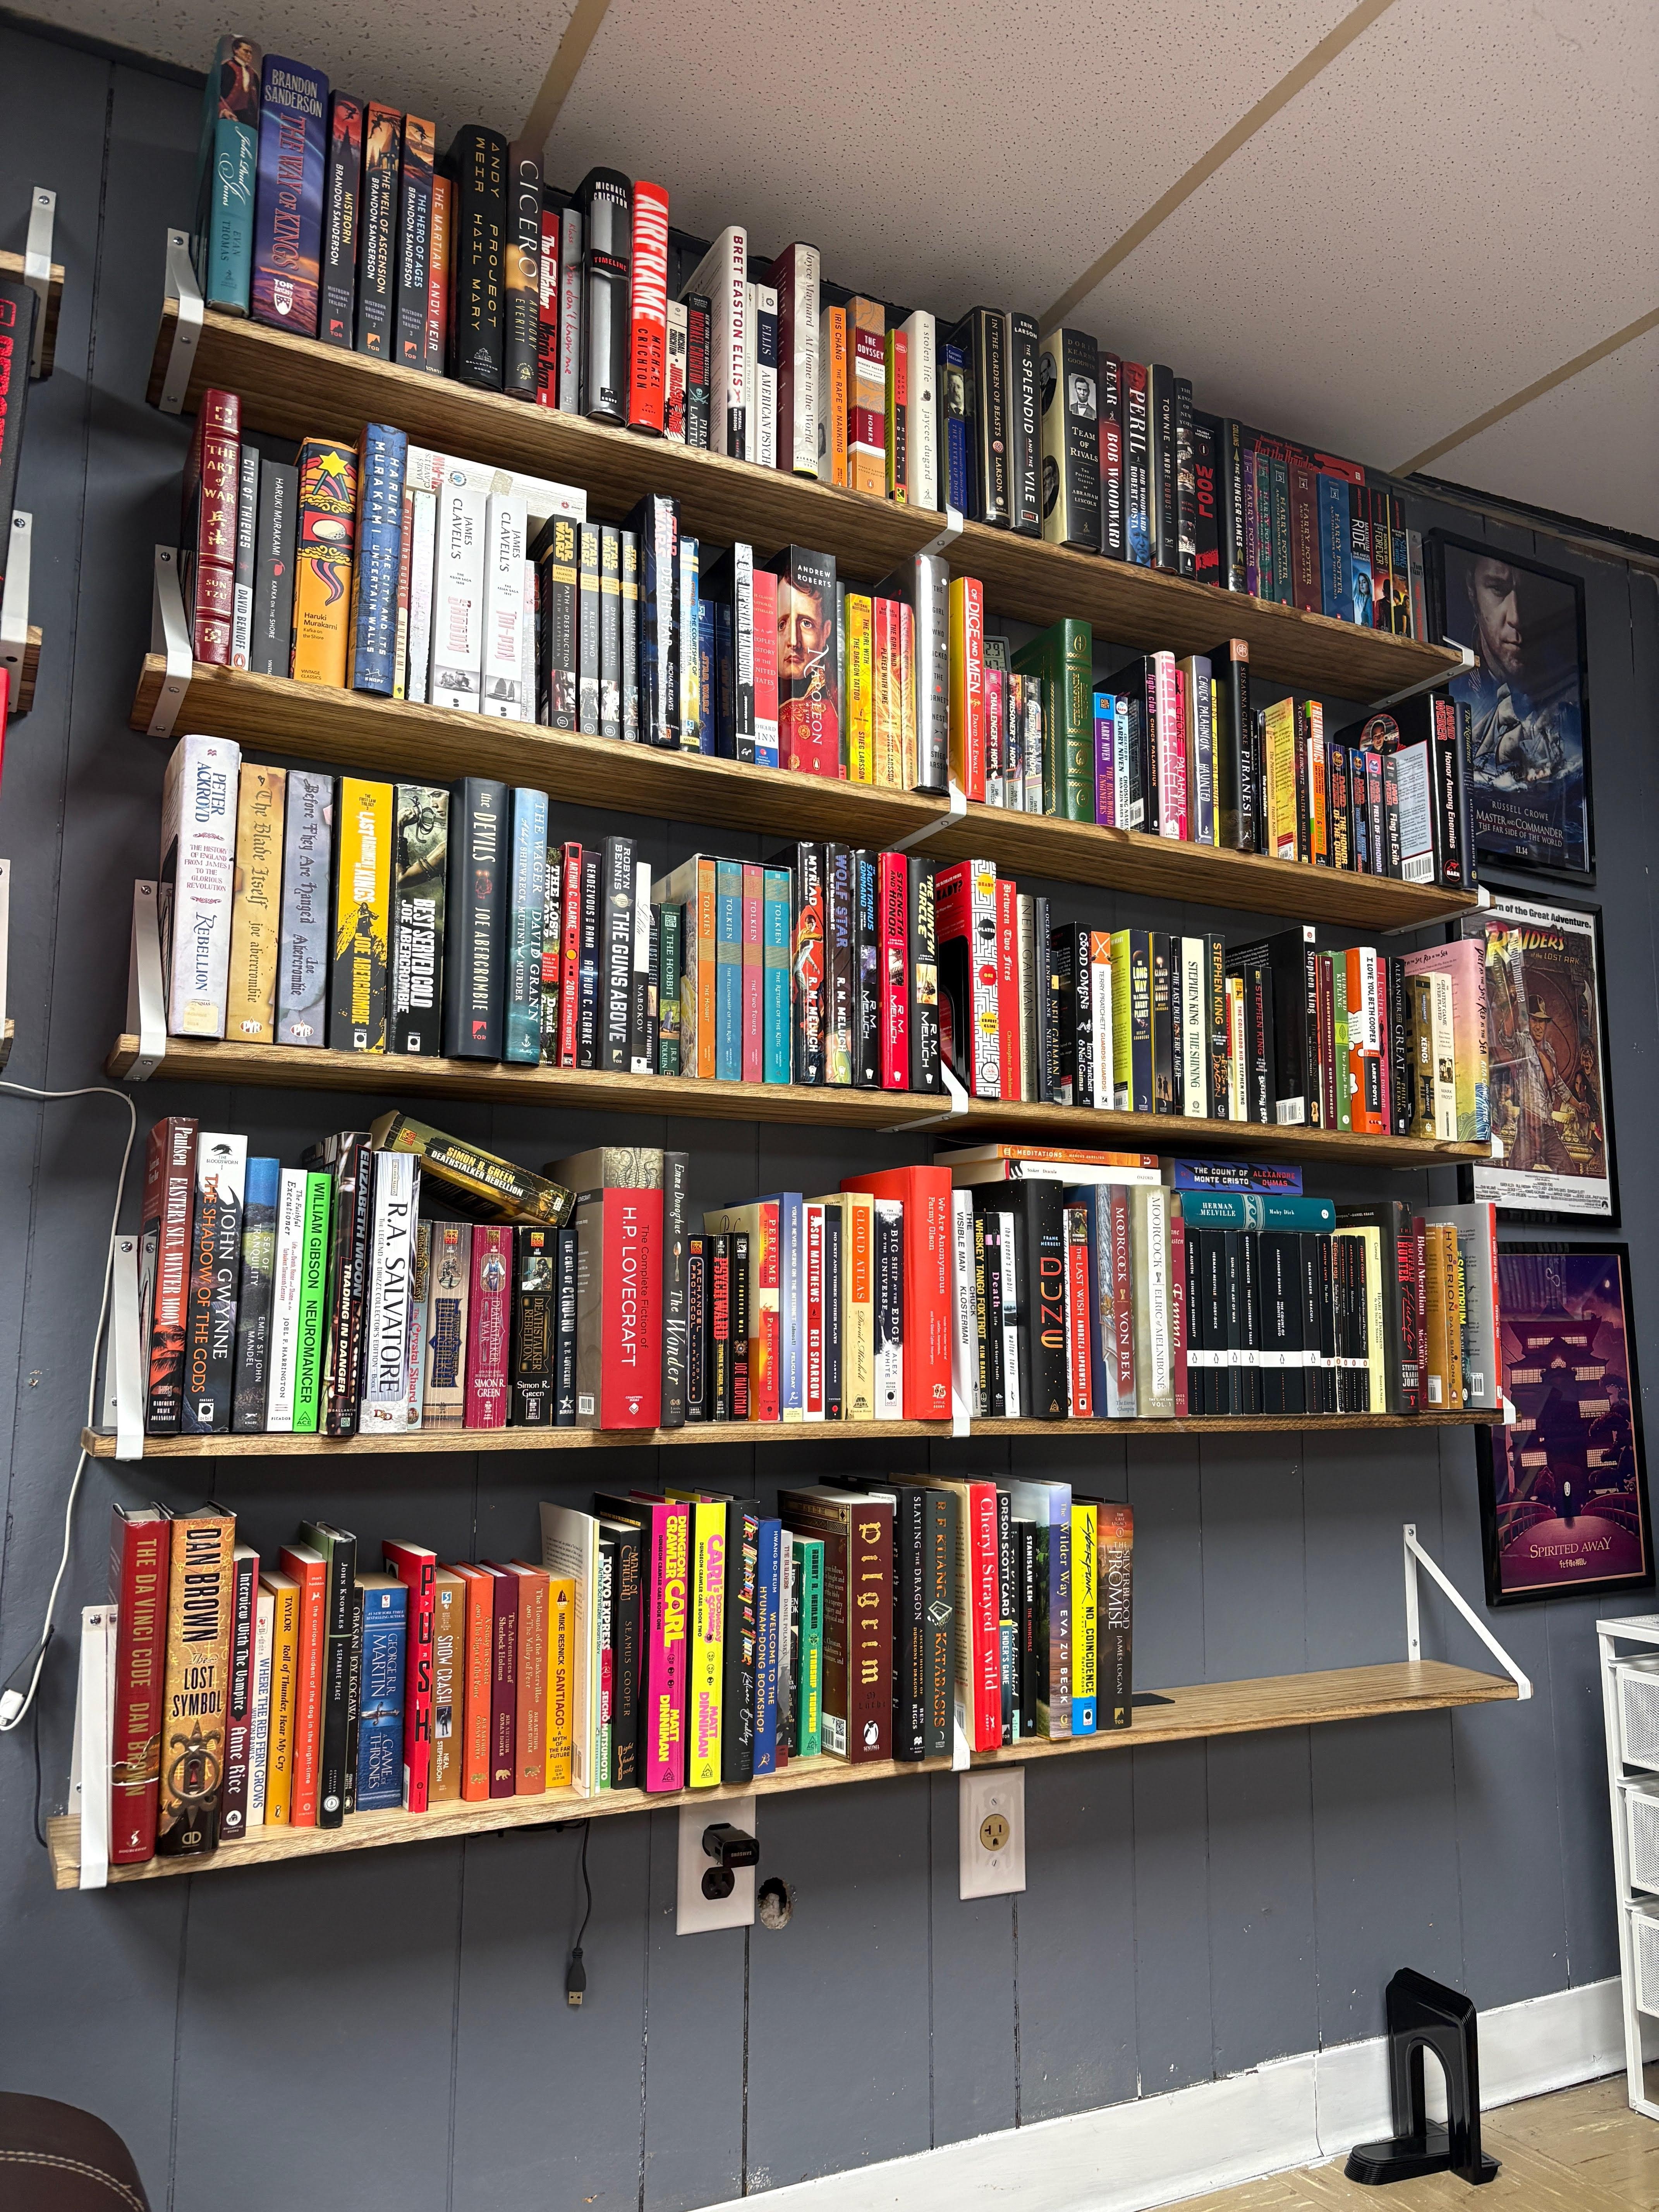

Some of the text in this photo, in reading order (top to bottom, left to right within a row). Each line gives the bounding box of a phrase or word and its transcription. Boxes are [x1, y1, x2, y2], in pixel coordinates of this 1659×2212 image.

[272, 69, 318, 99] BRANDON
[264, 89, 323, 118] SANDERSON
[273, 113, 306, 270] THE WAY OF KINGS
[344, 191, 353, 244] MISTBORN
[519, 160, 539, 277] CICERO
[594, 257, 627, 272] TIMELINE
[634, 194, 666, 328] AIRFRAME
[274, 279, 294, 290] TOR
[733, 235, 743, 387] BRET EASTON ELLIS
[857, 343, 884, 360] ODYSSEY
[865, 335, 876, 346] THE
[1106, 361, 1117, 405] FEAR
[1072, 426, 1096, 441] TEAM
[1130, 388, 1146, 452] PERIL
[208, 445, 236, 460] THE
[1070, 447, 1098, 462] RIVALS
[1080, 440, 1089, 448] OF
[207, 461, 236, 476] ART
[215, 476, 226, 487] of
[204, 488, 235, 504] WAR
[1352, 519, 1366, 550] RIDE
[797, 565, 831, 578] ANDREW
[797, 574, 831, 588] ROBERTS
[971, 588, 977, 600] OF
[304, 611, 327, 620] Haruki
[304, 619, 337, 630] Murakami
[969, 603, 980, 639] DICE
[970, 658, 980, 694] MEN
[1147, 674, 1156, 699] fight
[803, 644, 829, 745] NAPOLEON
[1312, 705, 1324, 766] FREAKONOMICS
[198, 762, 211, 823] ACKROYD
[211, 771, 226, 816] PETER
[1241, 750, 1252, 817] PIRANESI
[1446, 776, 1455, 810] Among
[1477, 811, 1506, 825] MASTER
[1515, 819, 1563, 840] COMMANDER
[1492, 801, 1549, 822] RUSSELL CROWE
[472, 812, 497, 862] DEVILS
[1447, 812, 1456, 849] Enemies
[1479, 822, 1492, 831] THE
[1492, 825, 1504, 835] FAR
[1504, 828, 1518, 837] SIDE
[1528, 833, 1540, 842] THE
[1541, 835, 1562, 848] WORLD
[200, 853, 227, 861] ENGLAND
[204, 846, 228, 854] HISTORY
[206, 860, 227, 869] JAMES
[1515, 845, 1528, 855] 11.14
[187, 882, 226, 891] REVOLUTION
[192, 875, 222, 883] GLORIOUS
[807, 855, 818, 907] MYRIAD
[1504, 905, 1513, 914] of
[1514, 907, 1528, 916] the
[1528, 909, 1549, 921] Great
[1550, 912, 1592, 928] Adventure.
[196, 912, 209, 992] REBELLION
[1545, 953, 1561, 962] LOST
[1188, 961, 1200, 1087] STEPHEN KING THE SHINING
[172, 1127, 193, 1166] Paulsen
[1017, 1149, 1062, 1158] MEDITATIONS
[446, 1147, 515, 1184] SIMON R. GREEN
[1253, 1171, 1296, 1180] ALEXANDRE
[1202, 1202, 1233, 1210] HERMAN
[855, 1209, 866, 1300] CLOUD ATLAS
[1115, 1207, 1127, 1283] MOORCOCK
[192, 1173, 219, 1392] THE SHADOW OF THE GODS
[620, 1206, 637, 1367] H.P. LOVECRAFT
[1445, 1231, 1455, 1312] HYPERION
[379, 1258, 405, 1393] SALVATORE
[297, 1300, 319, 1404] NEUROMANCER
[810, 1329, 819, 1399] RED SPARROW
[664, 1515, 678, 1579] CRAWLER
[677, 1515, 687, 1577] DUNGEON
[1530, 1537, 1611, 1558] SPIRITED AWAY
[600, 1556, 613, 1650] TOKYO EXPRESS
[978, 1498, 998, 1691] Cheryl Strayed wild
[1108, 1550, 1123, 1630] PROMISE
[130, 1538, 157, 1688] THE DA VINCI CODE
[664, 1579, 685, 1648] CARL
[184, 1665, 216, 1690] LOST
[436, 1635, 453, 1705] SNOW CRASH
[172, 1692, 222, 1717] SYMBOL
[555, 1669, 566, 1729] SANTIAGO:
[659, 1695, 670, 1762] DINNIMAN
[669, 1709, 680, 1742] MATT
